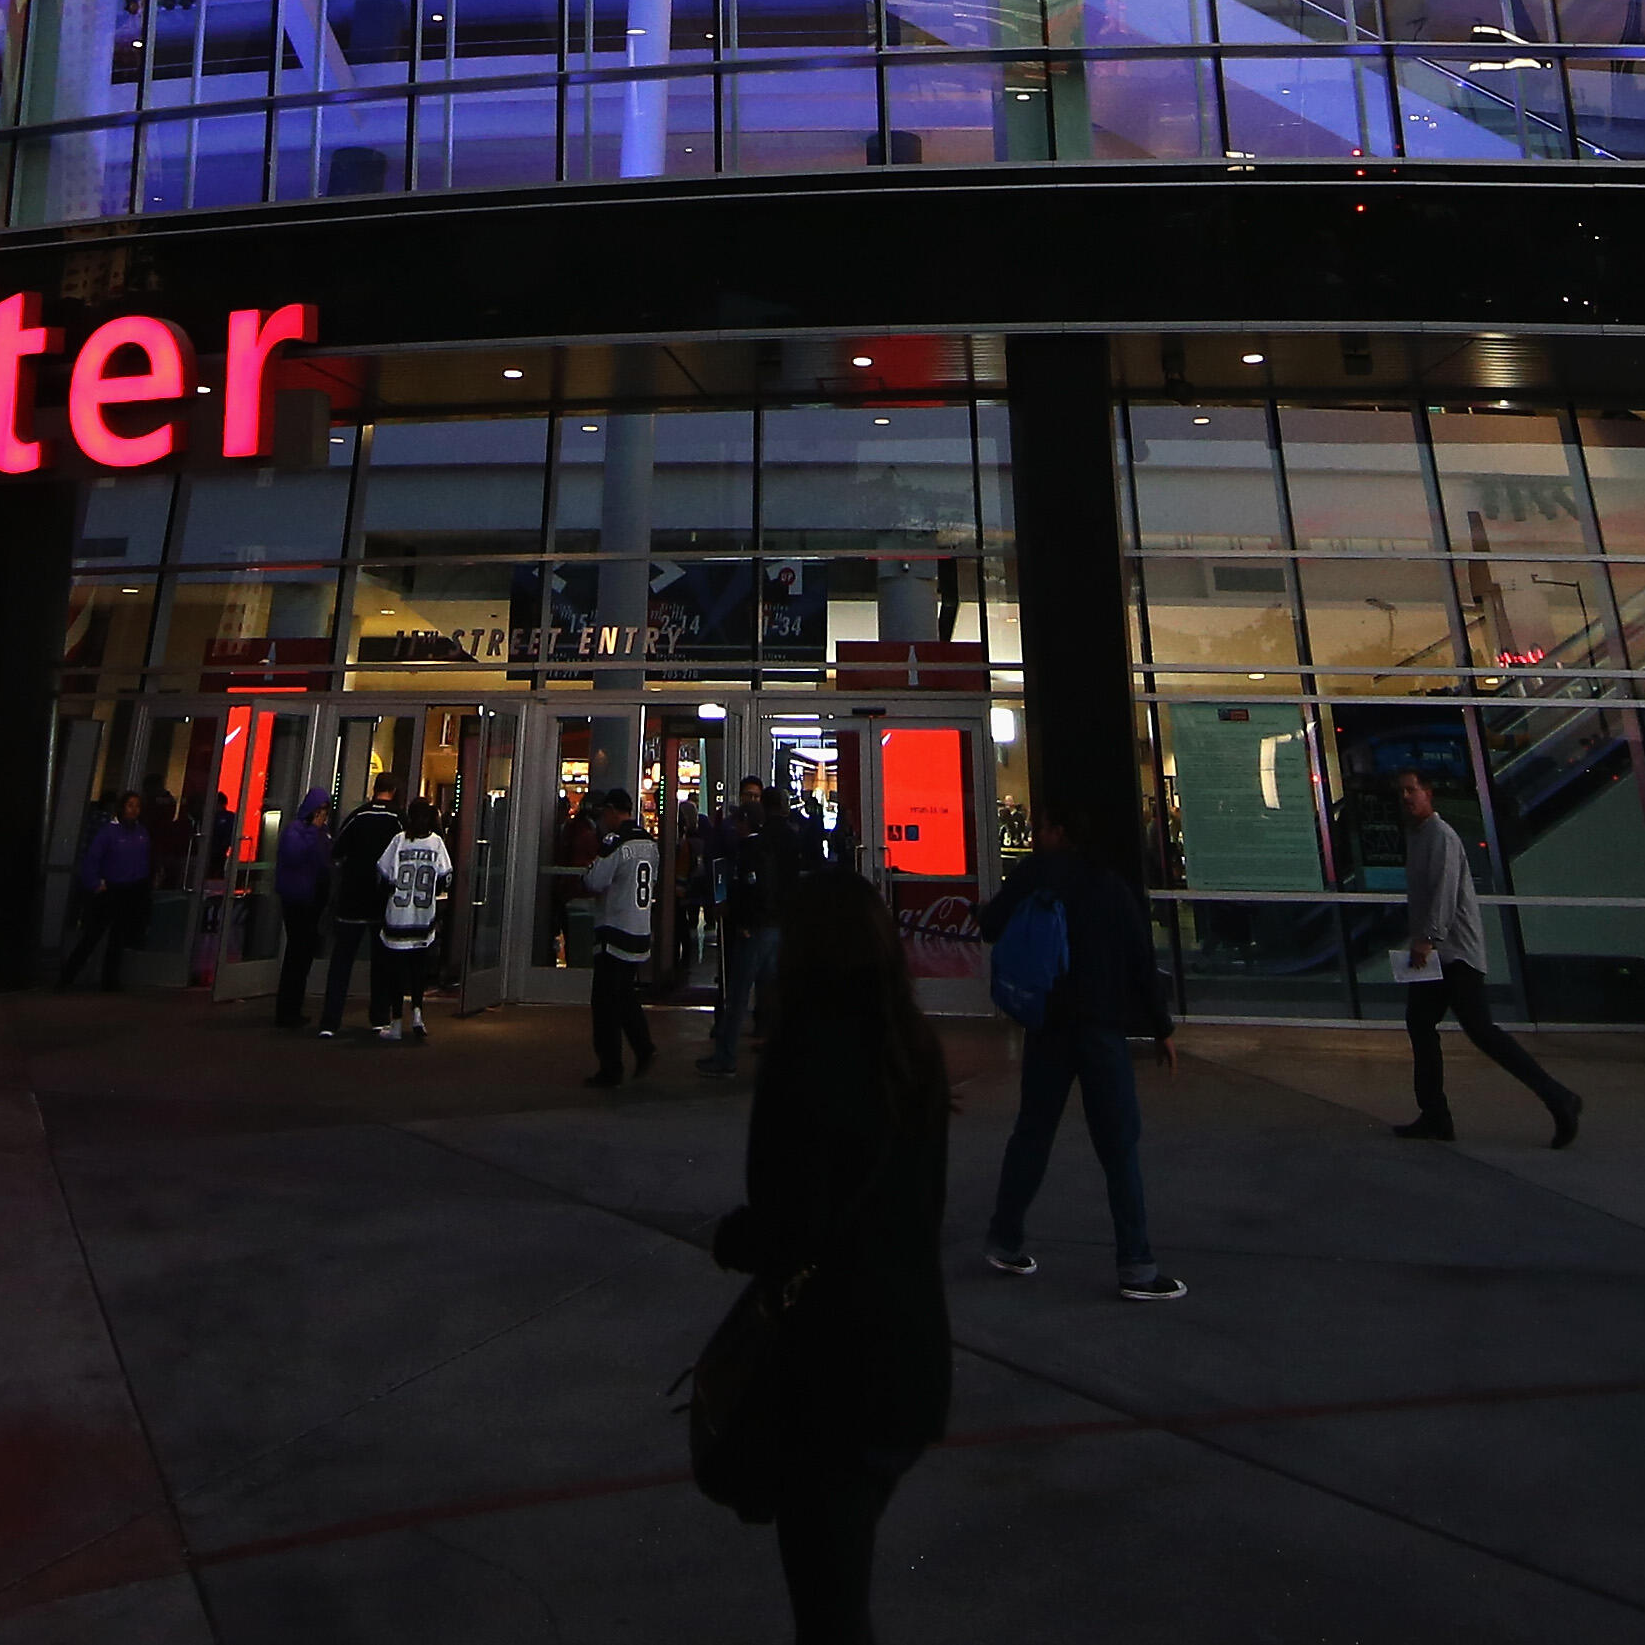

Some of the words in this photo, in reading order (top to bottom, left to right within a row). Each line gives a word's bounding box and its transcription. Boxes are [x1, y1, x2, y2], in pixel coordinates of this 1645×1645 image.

[451, 627, 564, 657] STREET
[577, 624, 685, 657] ENTRY
[393, 863, 437, 909] 99
[635, 860, 653, 910] 8
